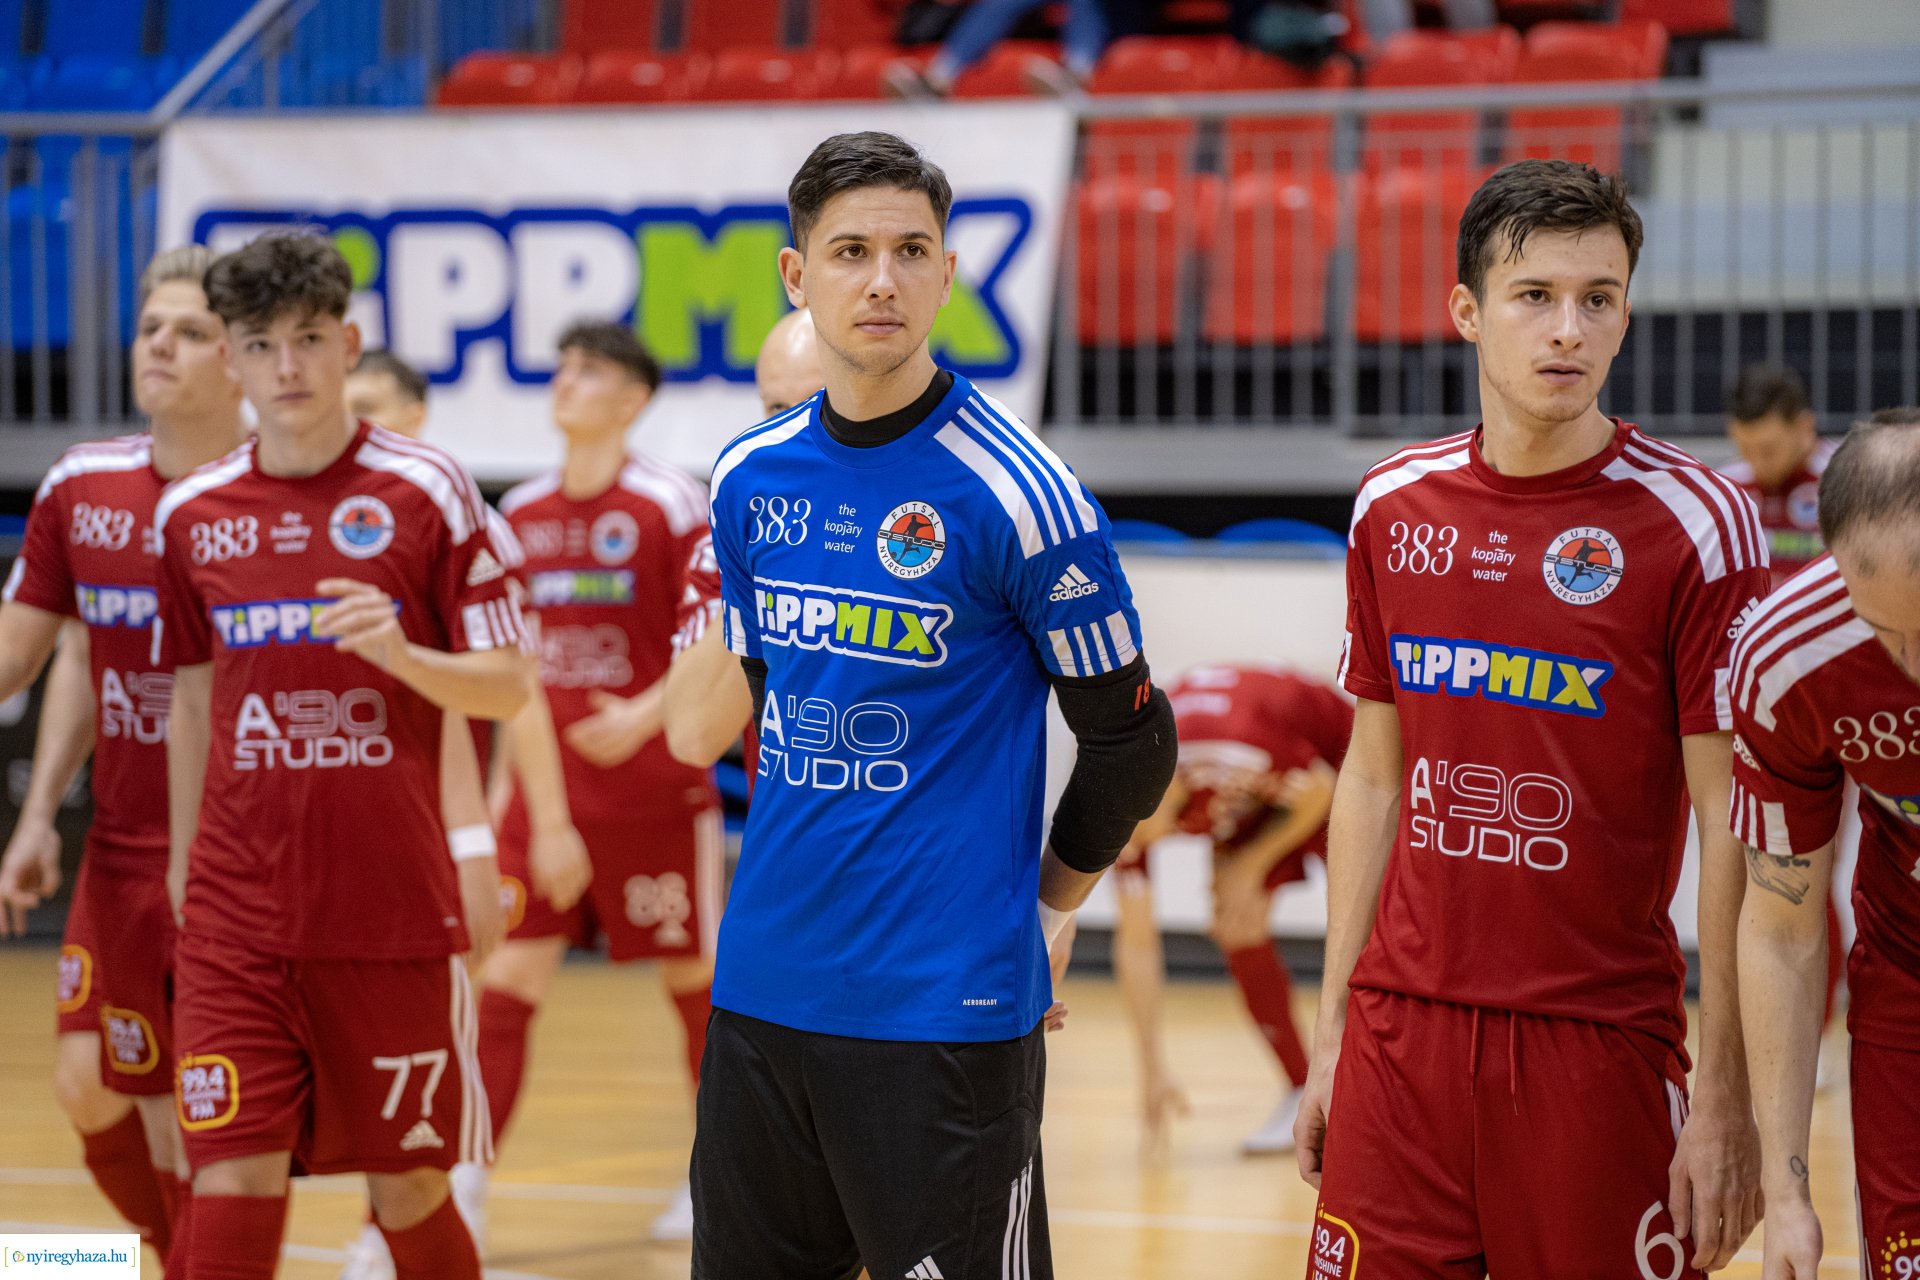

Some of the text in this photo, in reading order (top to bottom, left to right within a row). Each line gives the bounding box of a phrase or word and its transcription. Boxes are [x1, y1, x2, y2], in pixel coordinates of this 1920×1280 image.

[206, 212, 1023, 374] iPPMX
[749, 496, 811, 545] 383
[838, 503, 856, 516] the
[891, 503, 940, 528] FUTSAL
[190, 515, 259, 566] 383
[824, 541, 855, 553] water
[1387, 521, 1458, 576] 383
[1489, 530, 1508, 544] the
[1559, 528, 1618, 554] FUTSAL
[1049, 582, 1099, 602] adidas
[1472, 569, 1507, 582] water
[76, 583, 158, 626] TiPP
[235, 687, 388, 739] A'90
[761, 689, 909, 755] A'90
[233, 735, 393, 770] STUDIO
[758, 744, 909, 792] STUDIO
[1411, 757, 1573, 831] A'90
[1410, 815, 1569, 871] STUDIO
[372, 1048, 449, 1120] 77
[1634, 1201, 1685, 1280] 6
